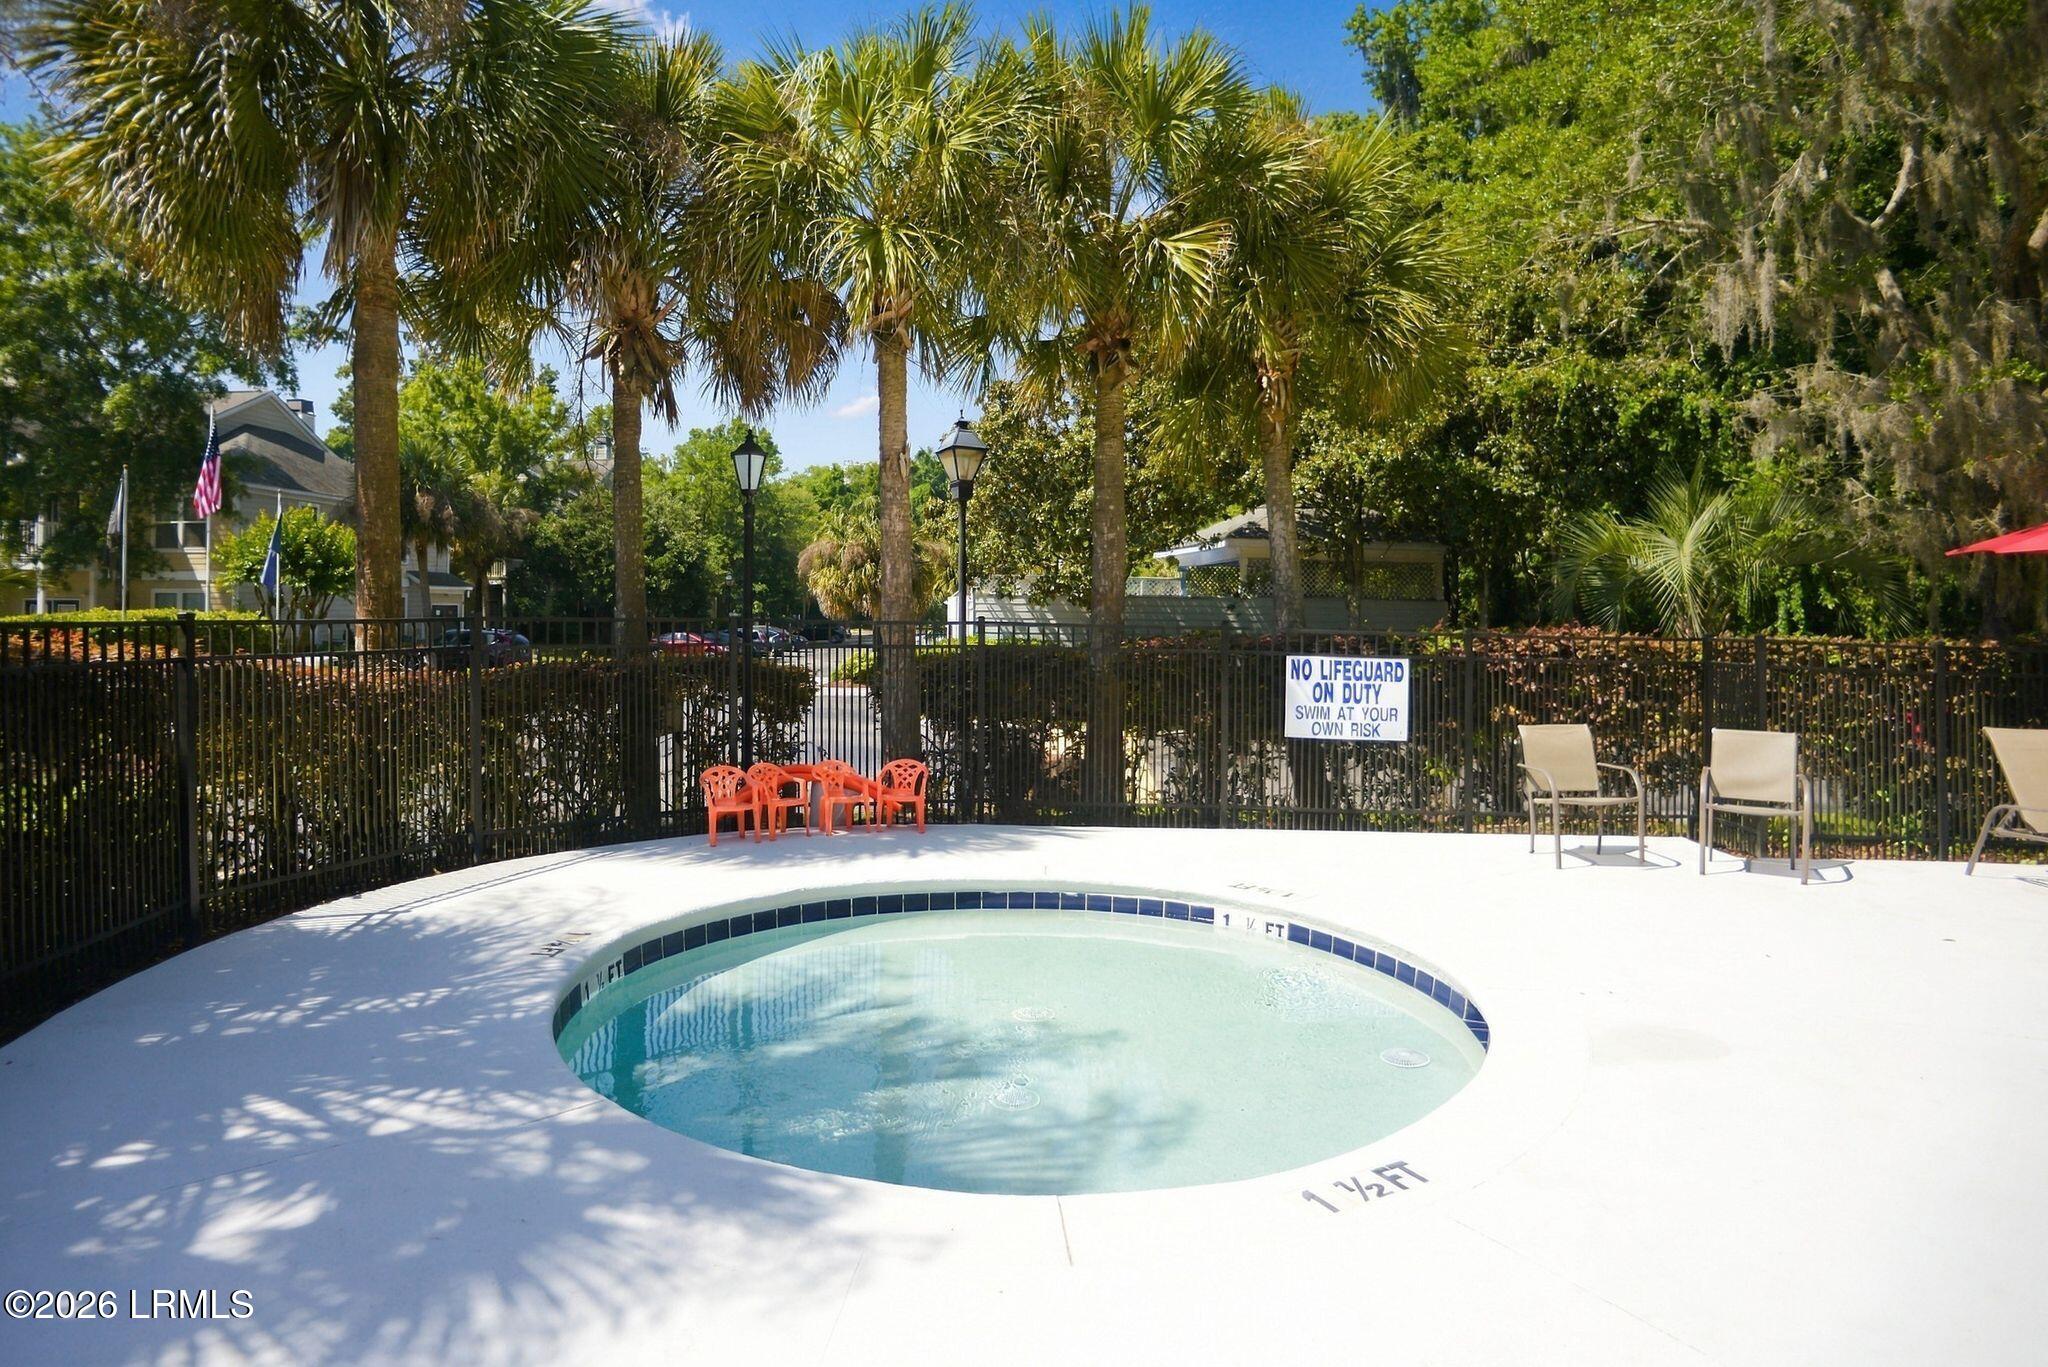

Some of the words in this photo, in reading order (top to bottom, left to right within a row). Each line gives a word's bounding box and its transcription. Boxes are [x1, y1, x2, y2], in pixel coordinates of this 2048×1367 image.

[1290, 658, 1312, 680] NO
[1320, 659, 1404, 682] LIFEGUARD
[1312, 681, 1334, 703] ON
[1342, 682, 1382, 704] DUTY
[1295, 705, 1330, 721] SWIM
[1337, 706, 1354, 721] AT
[1362, 707, 1398, 722] YOUR
[1311, 721, 1344, 736] OWN
[1350, 722, 1381, 738] RISK
[1223, 913, 1230, 926] 1
[1265, 921, 1285, 937] FT
[585, 981, 590, 1001] 1
[608, 959, 622, 983] FT
[1301, 1189, 1340, 1214] 1
[1371, 1160, 1430, 1191] FT
